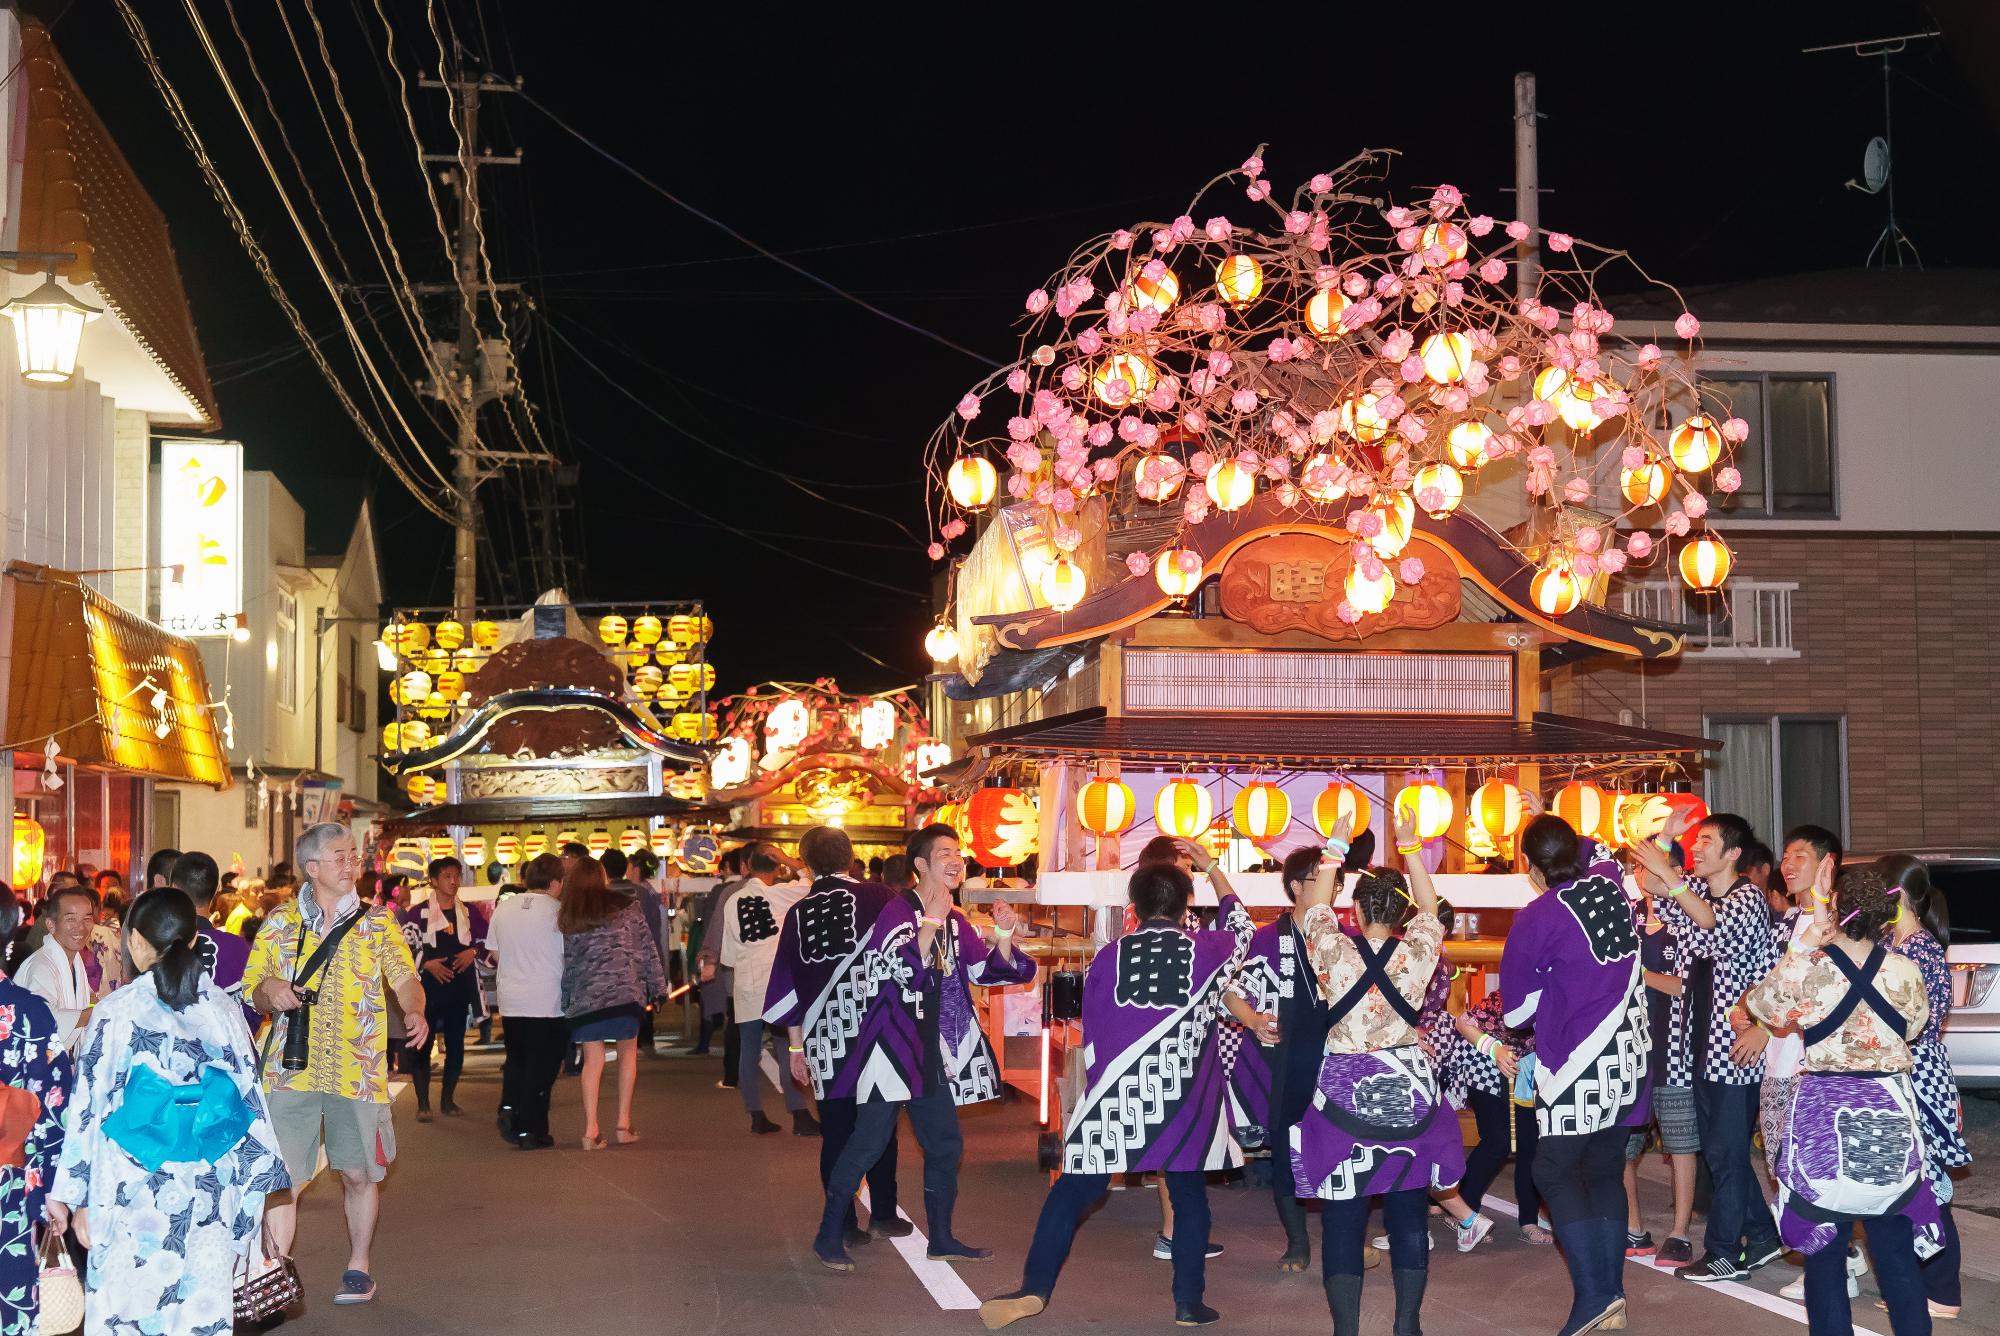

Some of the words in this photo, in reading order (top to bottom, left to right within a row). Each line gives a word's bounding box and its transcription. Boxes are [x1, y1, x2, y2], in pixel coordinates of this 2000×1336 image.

[737, 896, 779, 943] 睦
[796, 889, 857, 964] 睦
[1115, 928, 1195, 1009] 睦
